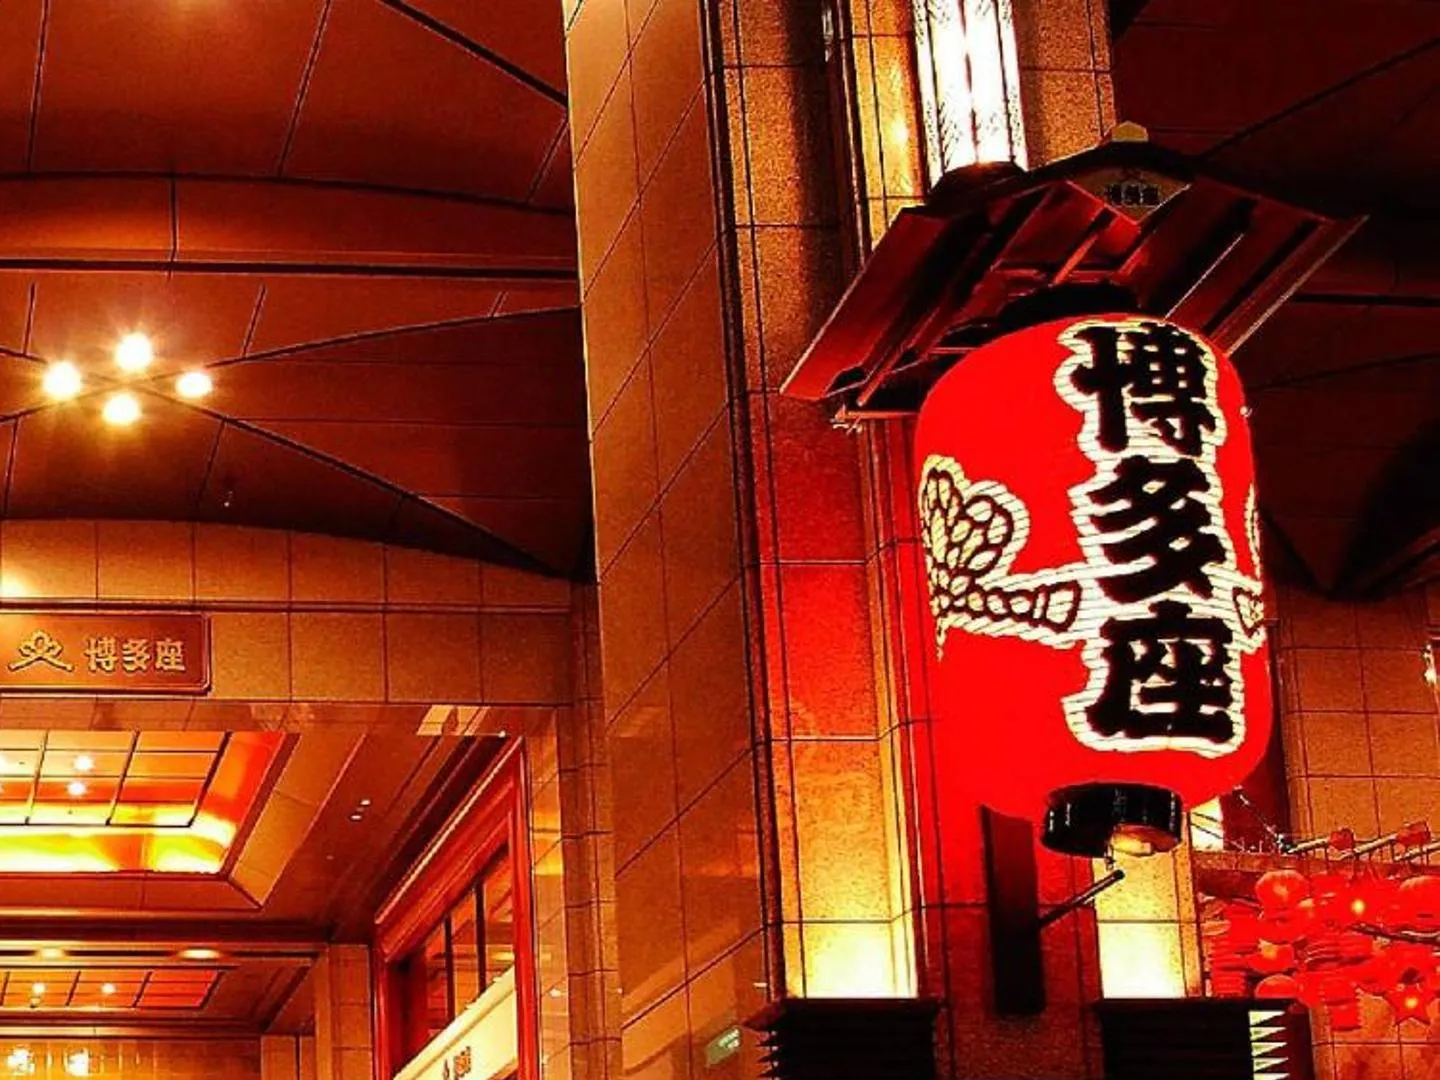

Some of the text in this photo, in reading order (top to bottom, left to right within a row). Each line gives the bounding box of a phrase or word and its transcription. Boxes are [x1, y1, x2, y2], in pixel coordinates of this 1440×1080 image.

[1070, 322, 1236, 744] 博多座
[83, 636, 187, 673] 博多座
